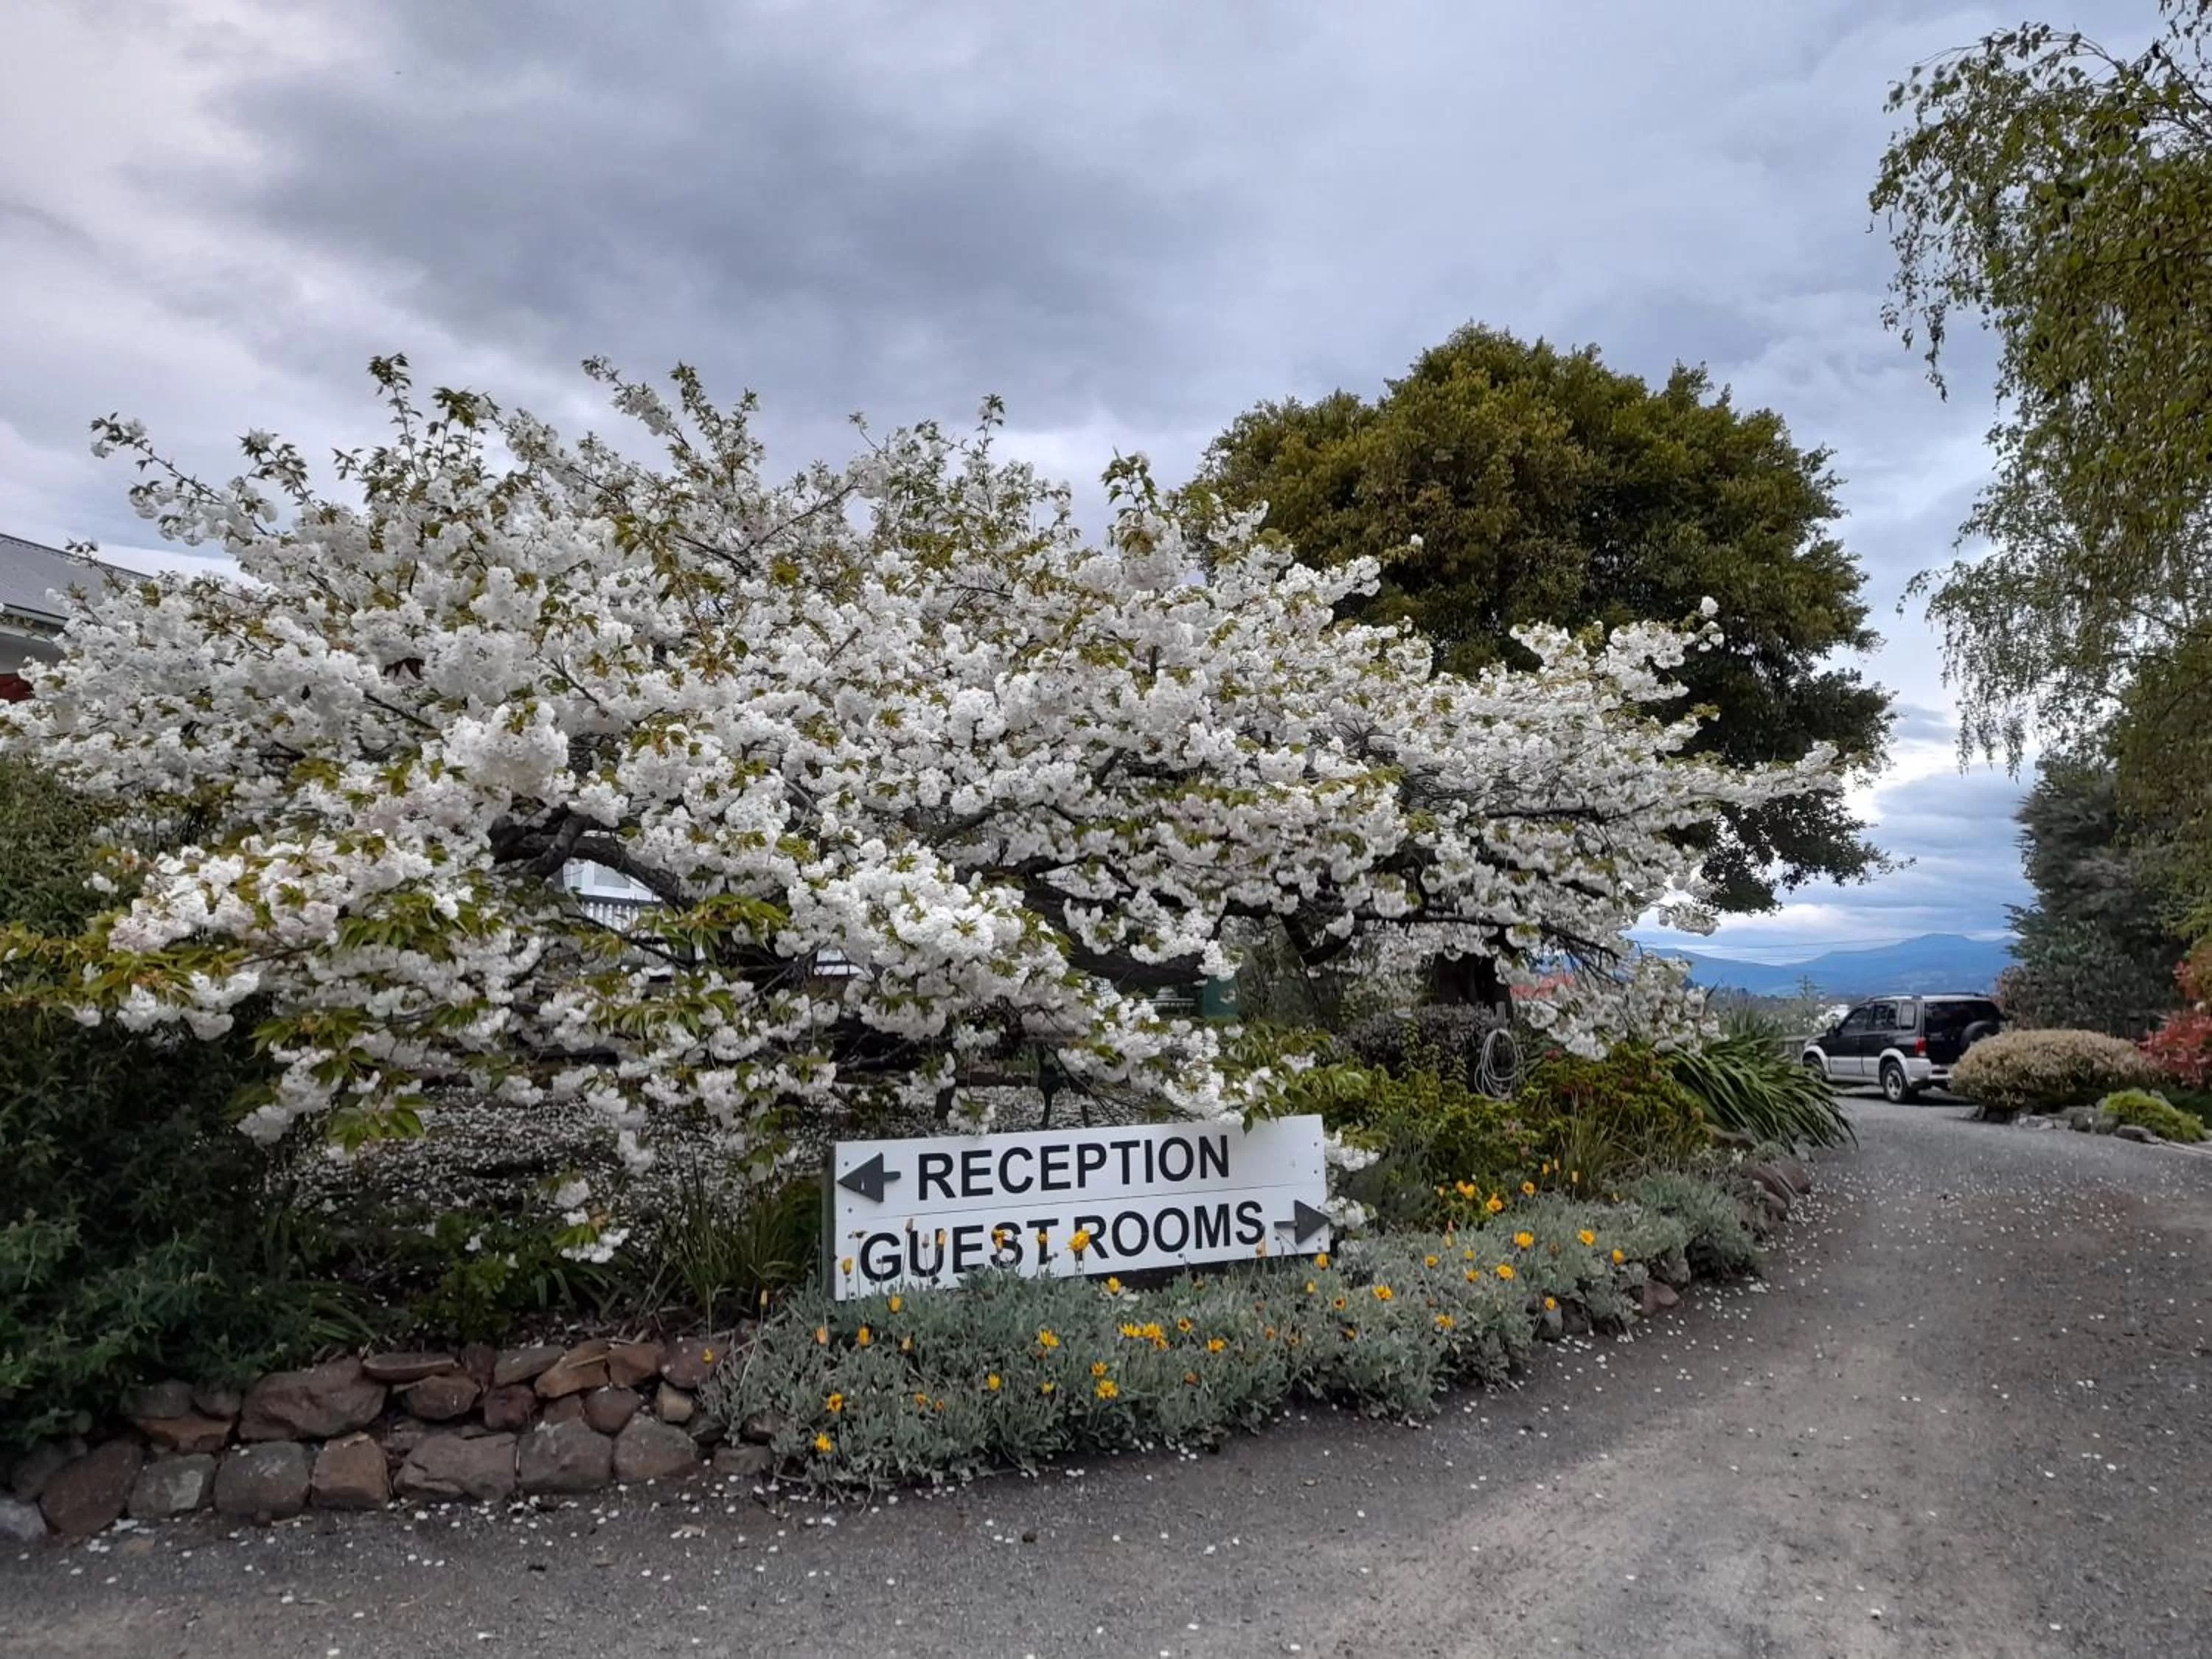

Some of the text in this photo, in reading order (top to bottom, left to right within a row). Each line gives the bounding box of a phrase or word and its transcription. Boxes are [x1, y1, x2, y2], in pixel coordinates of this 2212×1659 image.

[918, 1135, 1229, 1201] RECEPTION
[860, 1201, 1265, 1282] GUEST ROOMS
